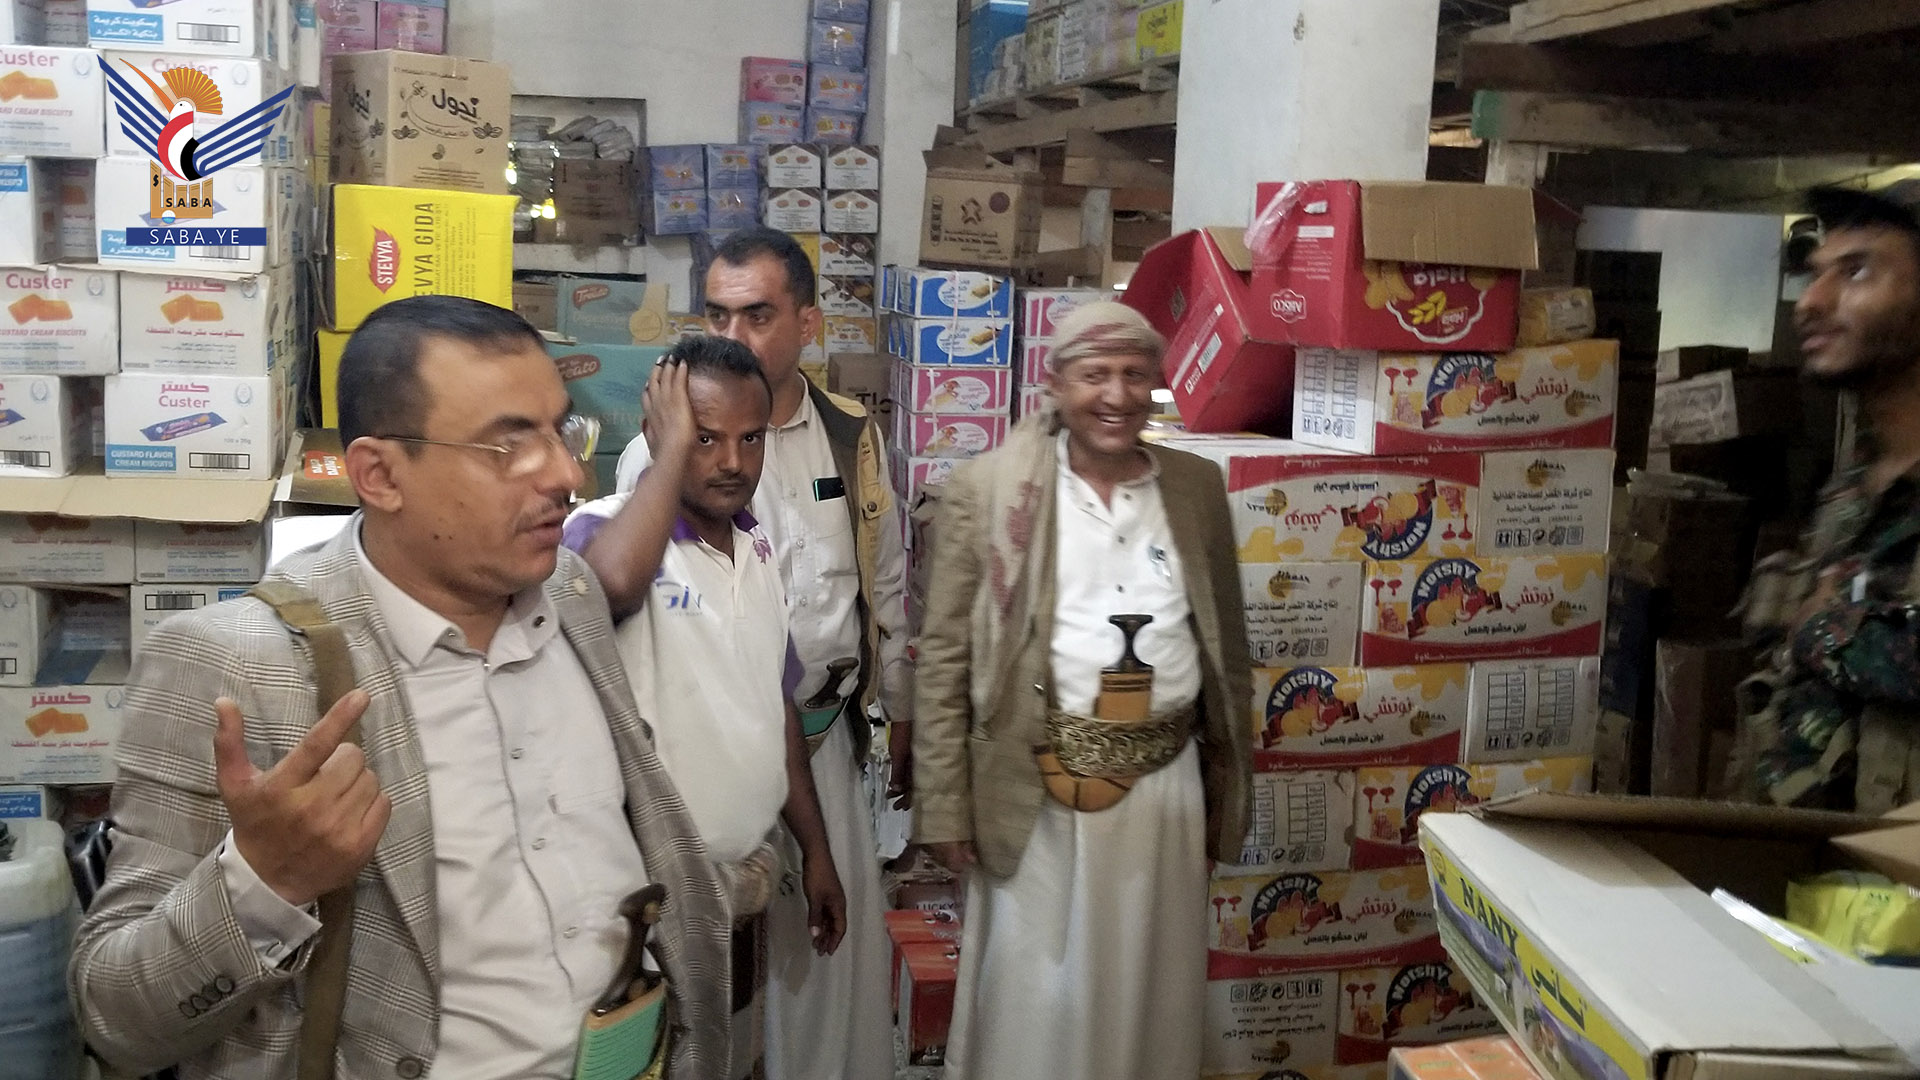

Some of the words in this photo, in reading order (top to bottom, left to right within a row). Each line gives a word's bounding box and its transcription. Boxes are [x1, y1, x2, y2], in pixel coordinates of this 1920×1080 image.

[414, 203, 434, 245] GIDA
[376, 240, 394, 285] STEVYA
[6, 273, 74, 290] Custer
[414, 254, 434, 297] EVYA
[160, 381, 210, 394] كستر
[158, 395, 211, 409] Custer
[111, 450, 144, 458] CUSTARD
[145, 451, 174, 459] FLAVOR
[114, 459, 141, 467] CREAM
[142, 460, 174, 469] BISCUITS
[30, 692, 92, 708] كستر
[1460, 876, 1519, 958] NANY
